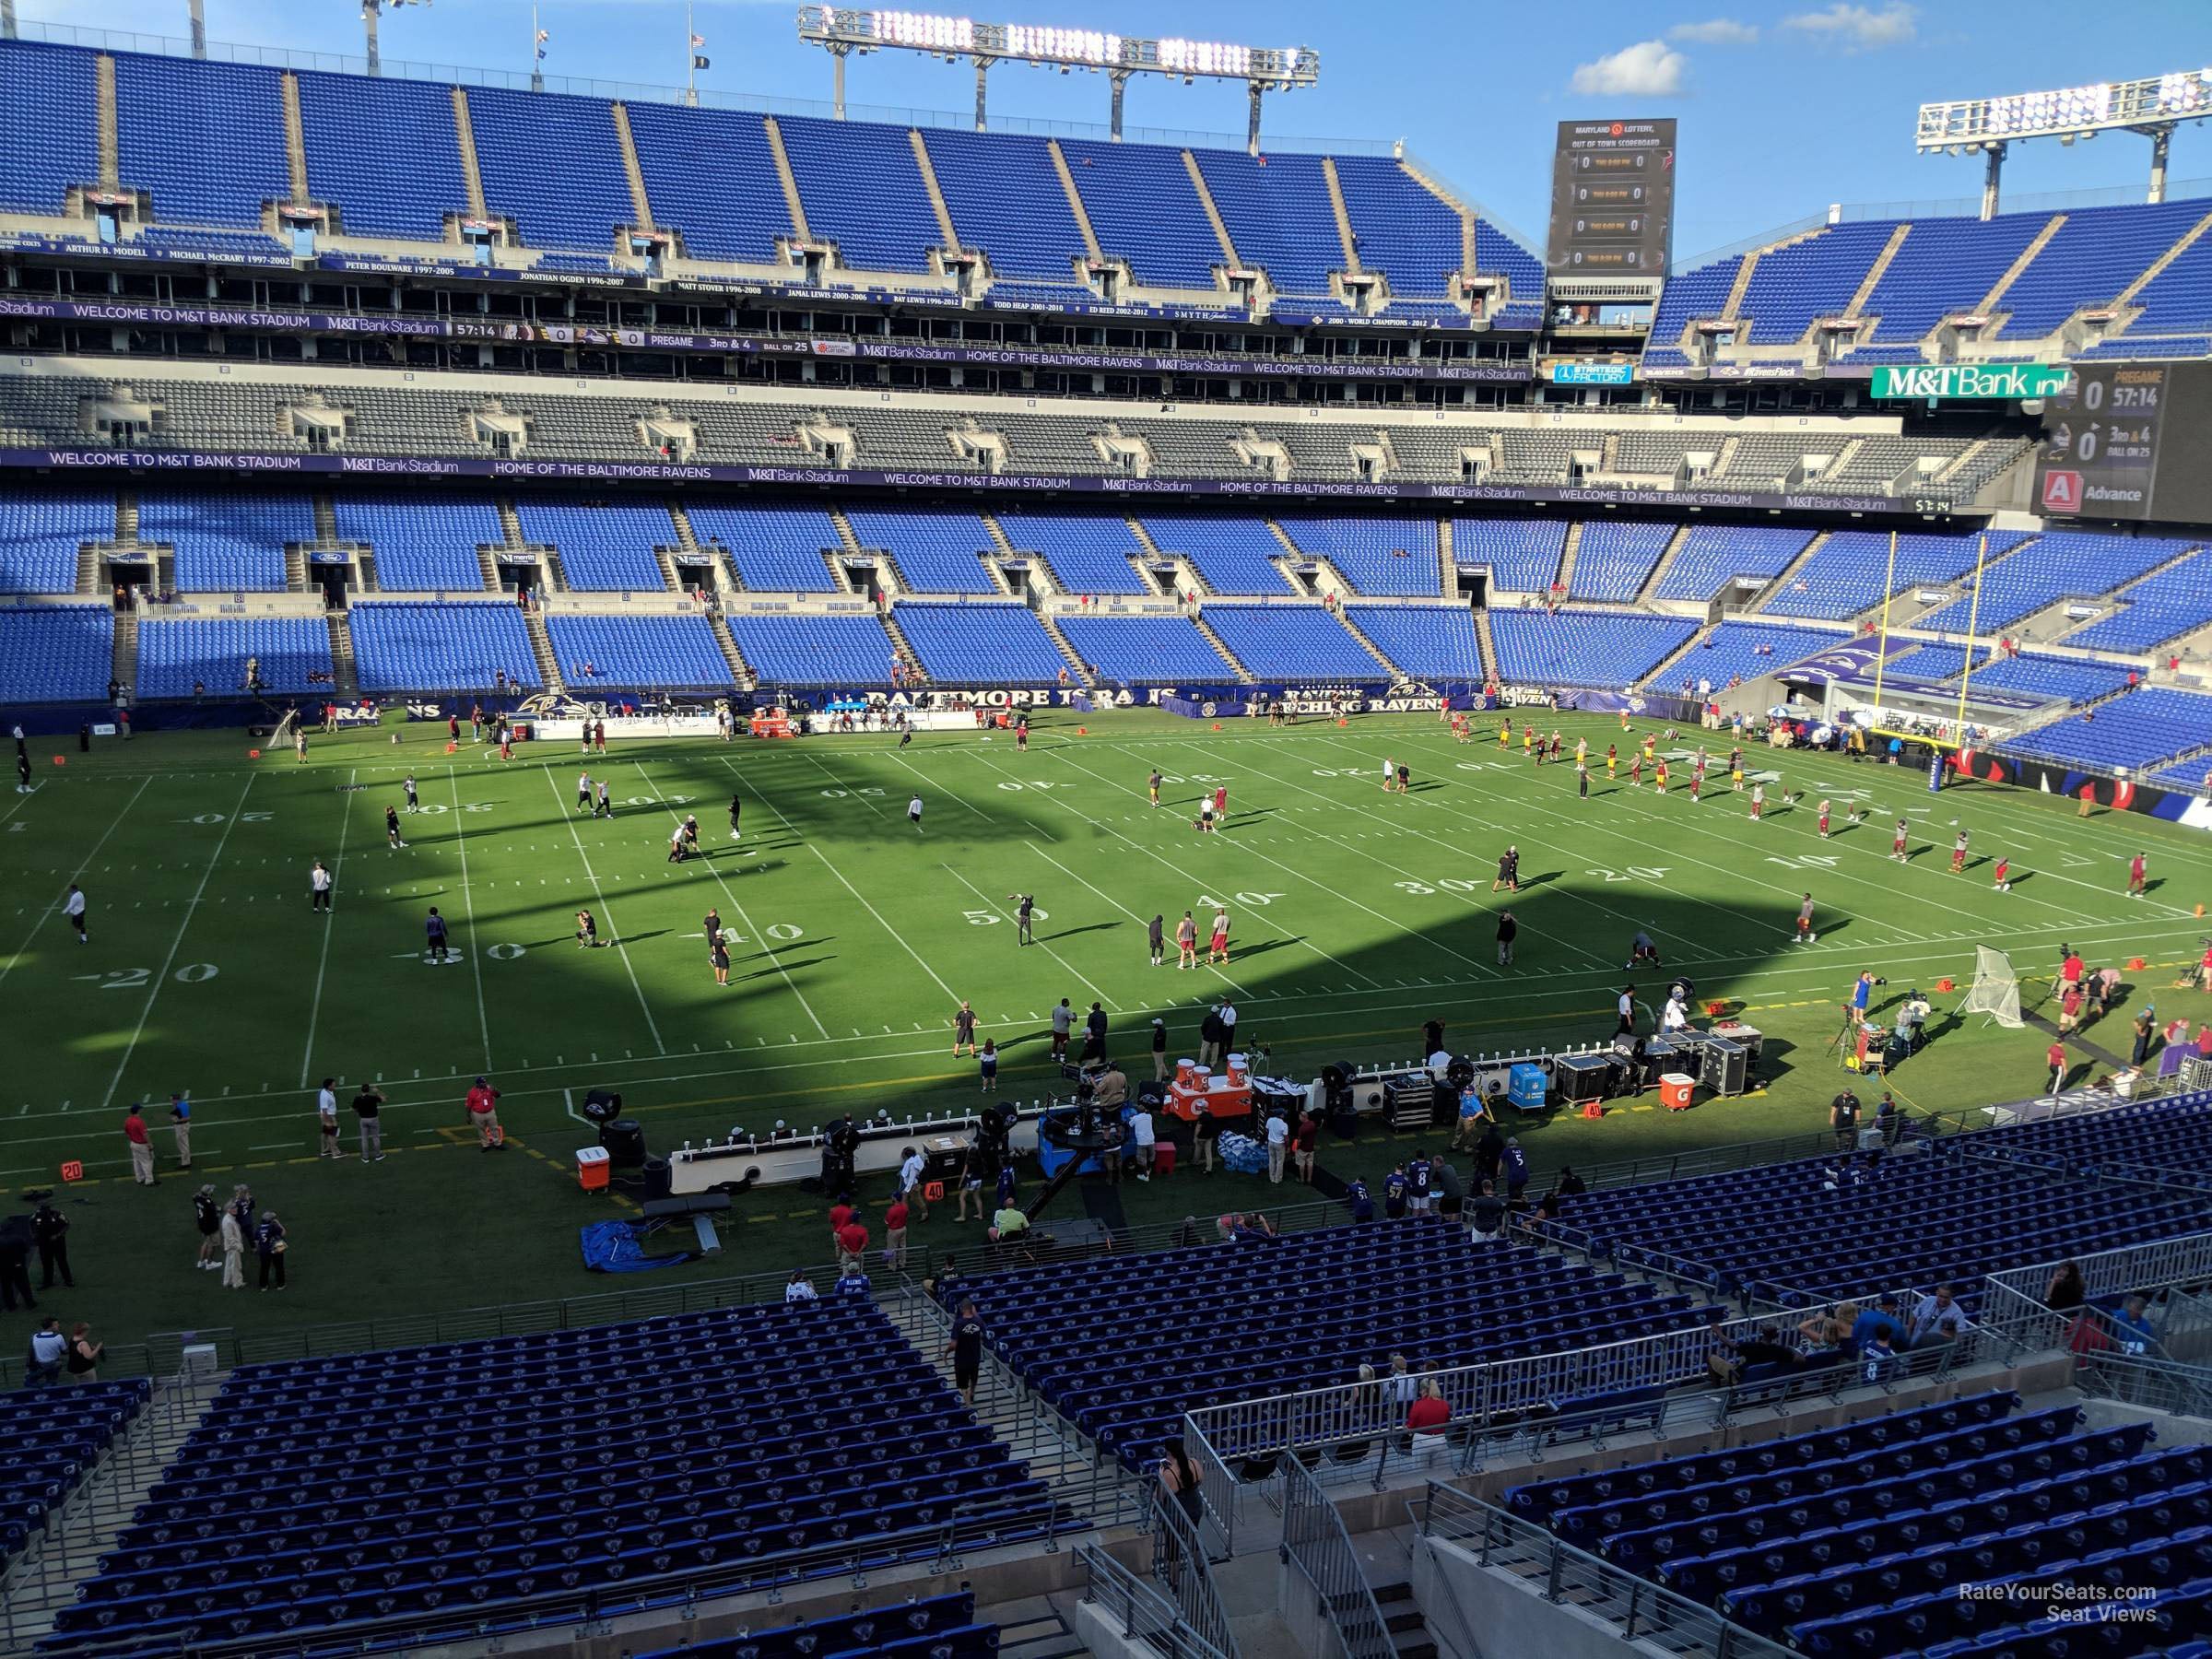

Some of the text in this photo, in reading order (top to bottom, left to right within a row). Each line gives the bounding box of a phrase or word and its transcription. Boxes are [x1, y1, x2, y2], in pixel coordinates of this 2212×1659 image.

[1618, 139, 1660, 147] SCOREBOARD
[1583, 157, 1590, 168] 0
[1637, 156, 1643, 167] 0
[1580, 189, 1587, 200] 0
[1633, 188, 1641, 199] 0
[1578, 220, 1584, 231] 0
[1631, 219, 1639, 230] 0
[66, 245, 100, 254] ARTHUR
[114, 249, 147, 257] MODELL
[170, 251, 206, 260] MICHAEL
[248, 256, 289, 265] 1997-2002
[1574, 253, 1582, 264] 0
[1628, 252, 1635, 263] 0
[347, 262, 454, 276] PETER BOULWARE 1997-2005
[520, 273, 624, 287] JONATHAN OGDEN 1996-2007
[678, 282, 761, 295] MATT STOVER 1996-2008
[787, 289, 809, 298] JAMAL
[833, 292, 867, 300] 2000-2006
[894, 295, 906, 303] RAY
[907, 296, 925, 304] LEWIS
[0, 300, 54, 315] Stadium
[1013, 302, 1030, 311] HEAP
[1099, 306, 1114, 314] REED
[1116, 308, 1148, 316] 2002-2012
[74, 305, 310, 327] WELCOME TO M&T BANK STADIUM
[1174, 311, 1208, 319] SMYTH
[328, 317, 439, 334] M&T Bank Stadium
[457, 324, 495, 336] 57:14
[557, 330, 566, 341] 0
[629, 334, 638, 345] 0
[652, 335, 693, 347] PREGAME
[743, 340, 750, 349] 4
[763, 343, 807, 352] BALL 25
[864, 345, 890, 357] M&T
[890, 347, 914, 358] Bank
[915, 348, 956, 360] Stadium
[967, 351, 1142, 368] HOME OF THE BALTIMORE RAVENS
[1156, 359, 1241, 372] M&T Bank Stadium
[1254, 363, 1423, 377] WELCOME TO M&T BANK STADIUM
[1436, 368, 1525, 380] M&T Bank Stadium
[1572, 372, 1625, 382] FACTORY
[1887, 368, 1958, 395] M&T
[1958, 366, 2028, 395] Bank
[2114, 371, 2162, 383] PREGAME
[2086, 382, 2103, 410] 0
[2112, 387, 2157, 406] 57:14
[2140, 426, 2150, 442] 4
[2079, 432, 2096, 461] 0
[2139, 447, 2150, 457] 25
[50, 453, 300, 469] WELCOME TO M&T BANK STADIUM
[343, 458, 459, 473] M&T Bank Stadium
[496, 463, 711, 478] HOME OF THE BALTIMORE RAVENS
[748, 468, 849, 483] M&T Bank Stadium
[885, 474, 1070, 488] WELCOME TO M&T BANK STADIUM
[1102, 479, 1192, 492] M&T Bank Stadium
[1220, 482, 1398, 495] HOME OF THE BALTIMORE RAVENS
[1431, 486, 1525, 499] M&T Bank Stadium
[2047, 476, 2071, 501] A
[2085, 487, 2142, 501] Advance
[1559, 490, 1751, 505] WELCOME TO M&T BANK STADIUM
[1786, 496, 1886, 511] M&T Bank Stadium
[1915, 500, 1949, 512] 57:14
[63, 1163, 81, 1180] 20
[1418, 1172, 1427, 1186] 8
[929, 1184, 942, 1199] 40
